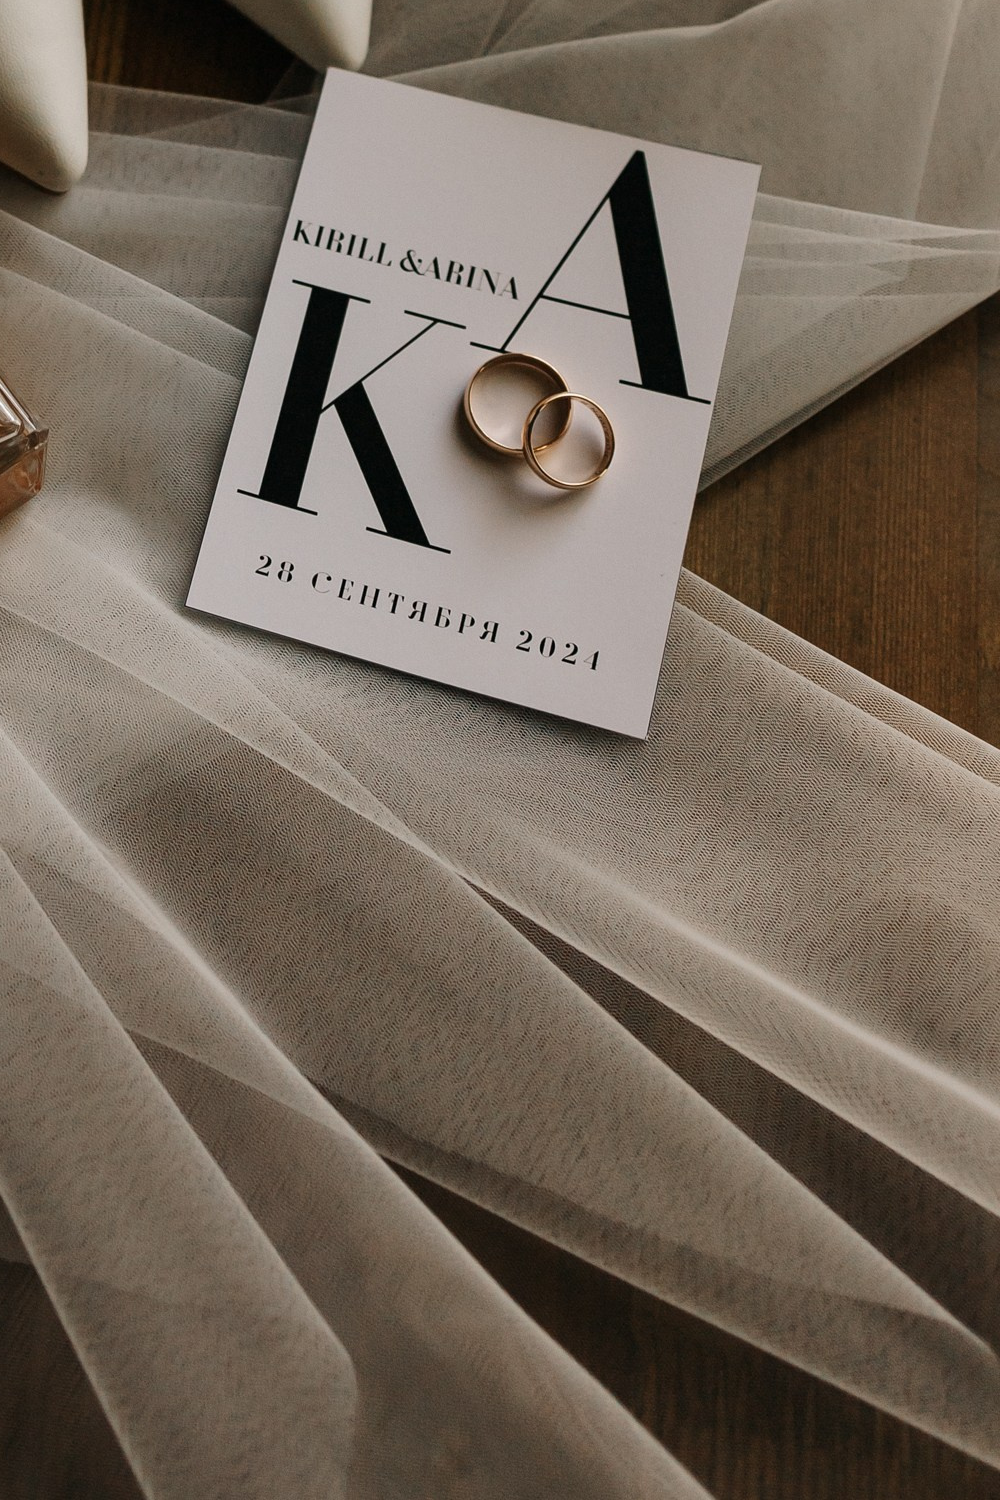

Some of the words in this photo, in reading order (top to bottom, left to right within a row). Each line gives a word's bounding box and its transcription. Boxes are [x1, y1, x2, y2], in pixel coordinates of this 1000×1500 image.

[292, 219, 393, 267] KIRILL
[469, 149, 712, 405] A
[236, 279, 467, 555] K
[254, 554, 296, 584] 28
[311, 571, 501, 644] СЕНТЯБРЯ
[515, 629, 601, 671] 2024
